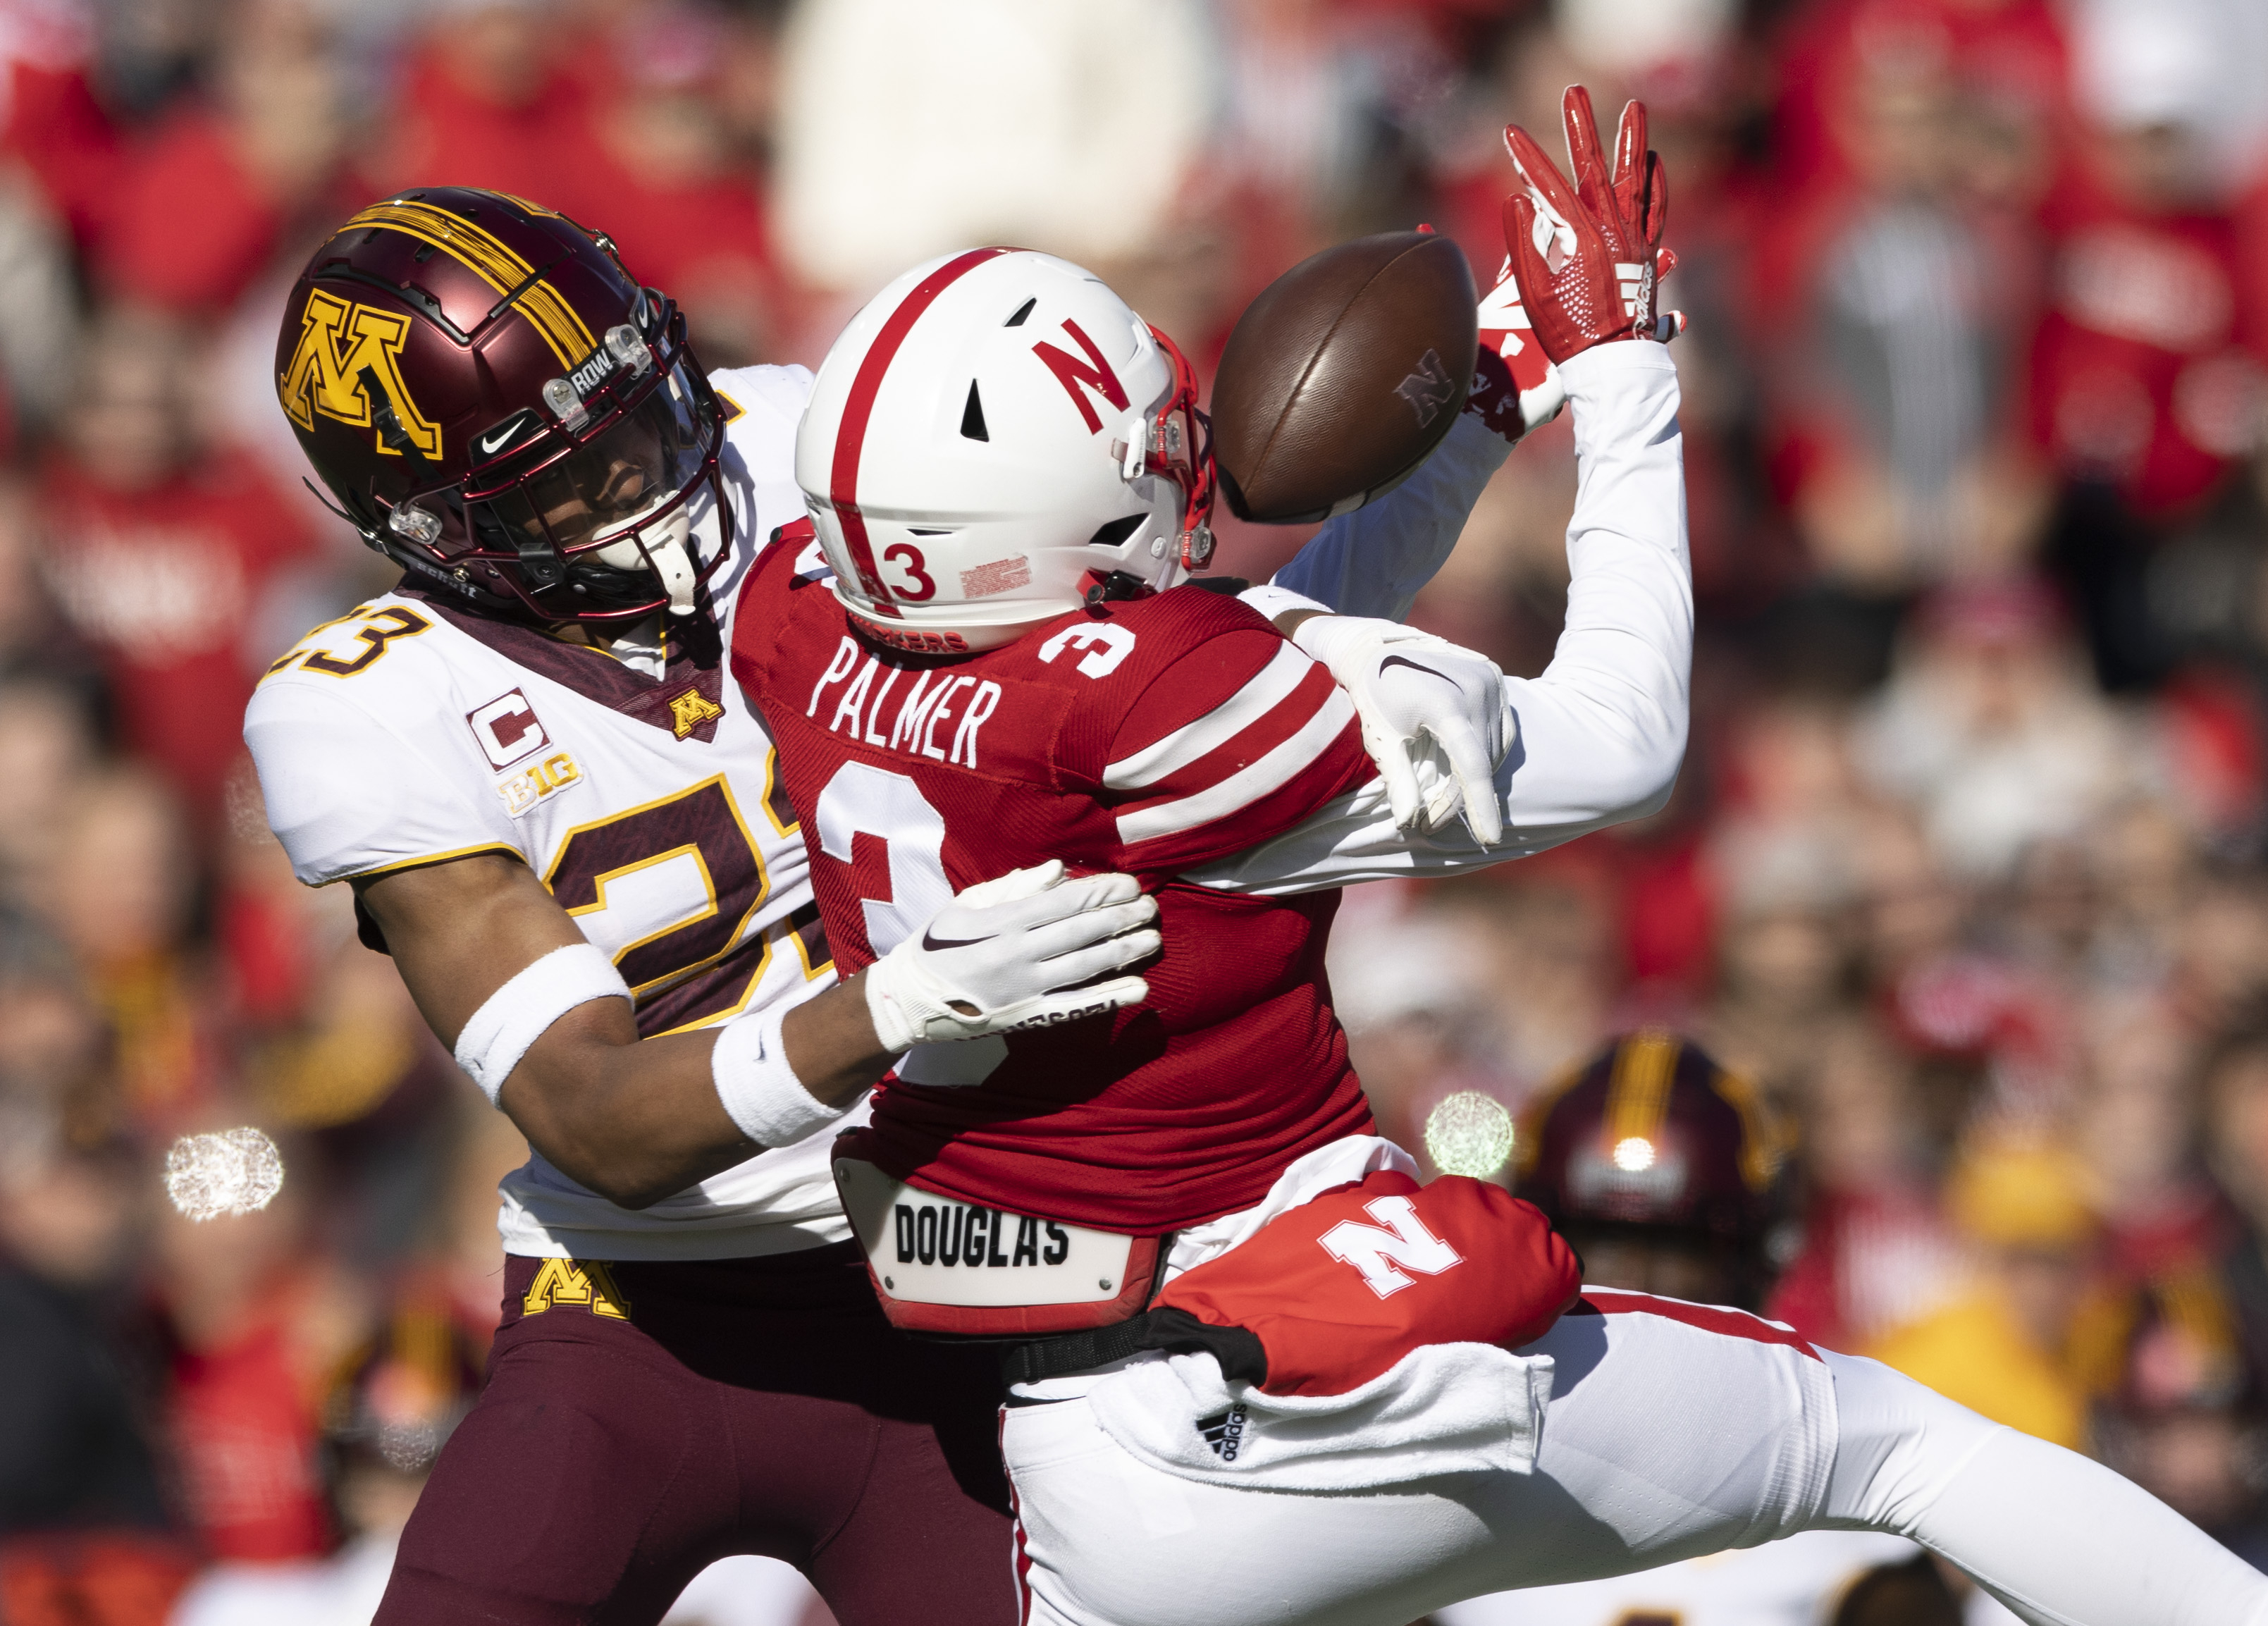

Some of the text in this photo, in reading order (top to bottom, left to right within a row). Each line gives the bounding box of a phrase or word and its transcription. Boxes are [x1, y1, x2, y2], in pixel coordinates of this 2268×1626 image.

[281, 288, 443, 460] M
[571, 348, 613, 395] ROW
[1031, 317, 1131, 436] N
[1391, 347, 1455, 429] N
[884, 543, 936, 601] 3
[1037, 622, 1136, 679] 3
[470, 693, 545, 767] C
[668, 688, 723, 738] M
[806, 635, 1002, 769] PALMER
[541, 745, 836, 1042] 2
[816, 760, 1009, 1086] 3
[895, 1204, 1069, 1267] DOUGLAS
[1316, 1195, 1465, 1300] N
[522, 1257, 631, 1320] M
[1224, 1403, 1247, 1461] adidas
